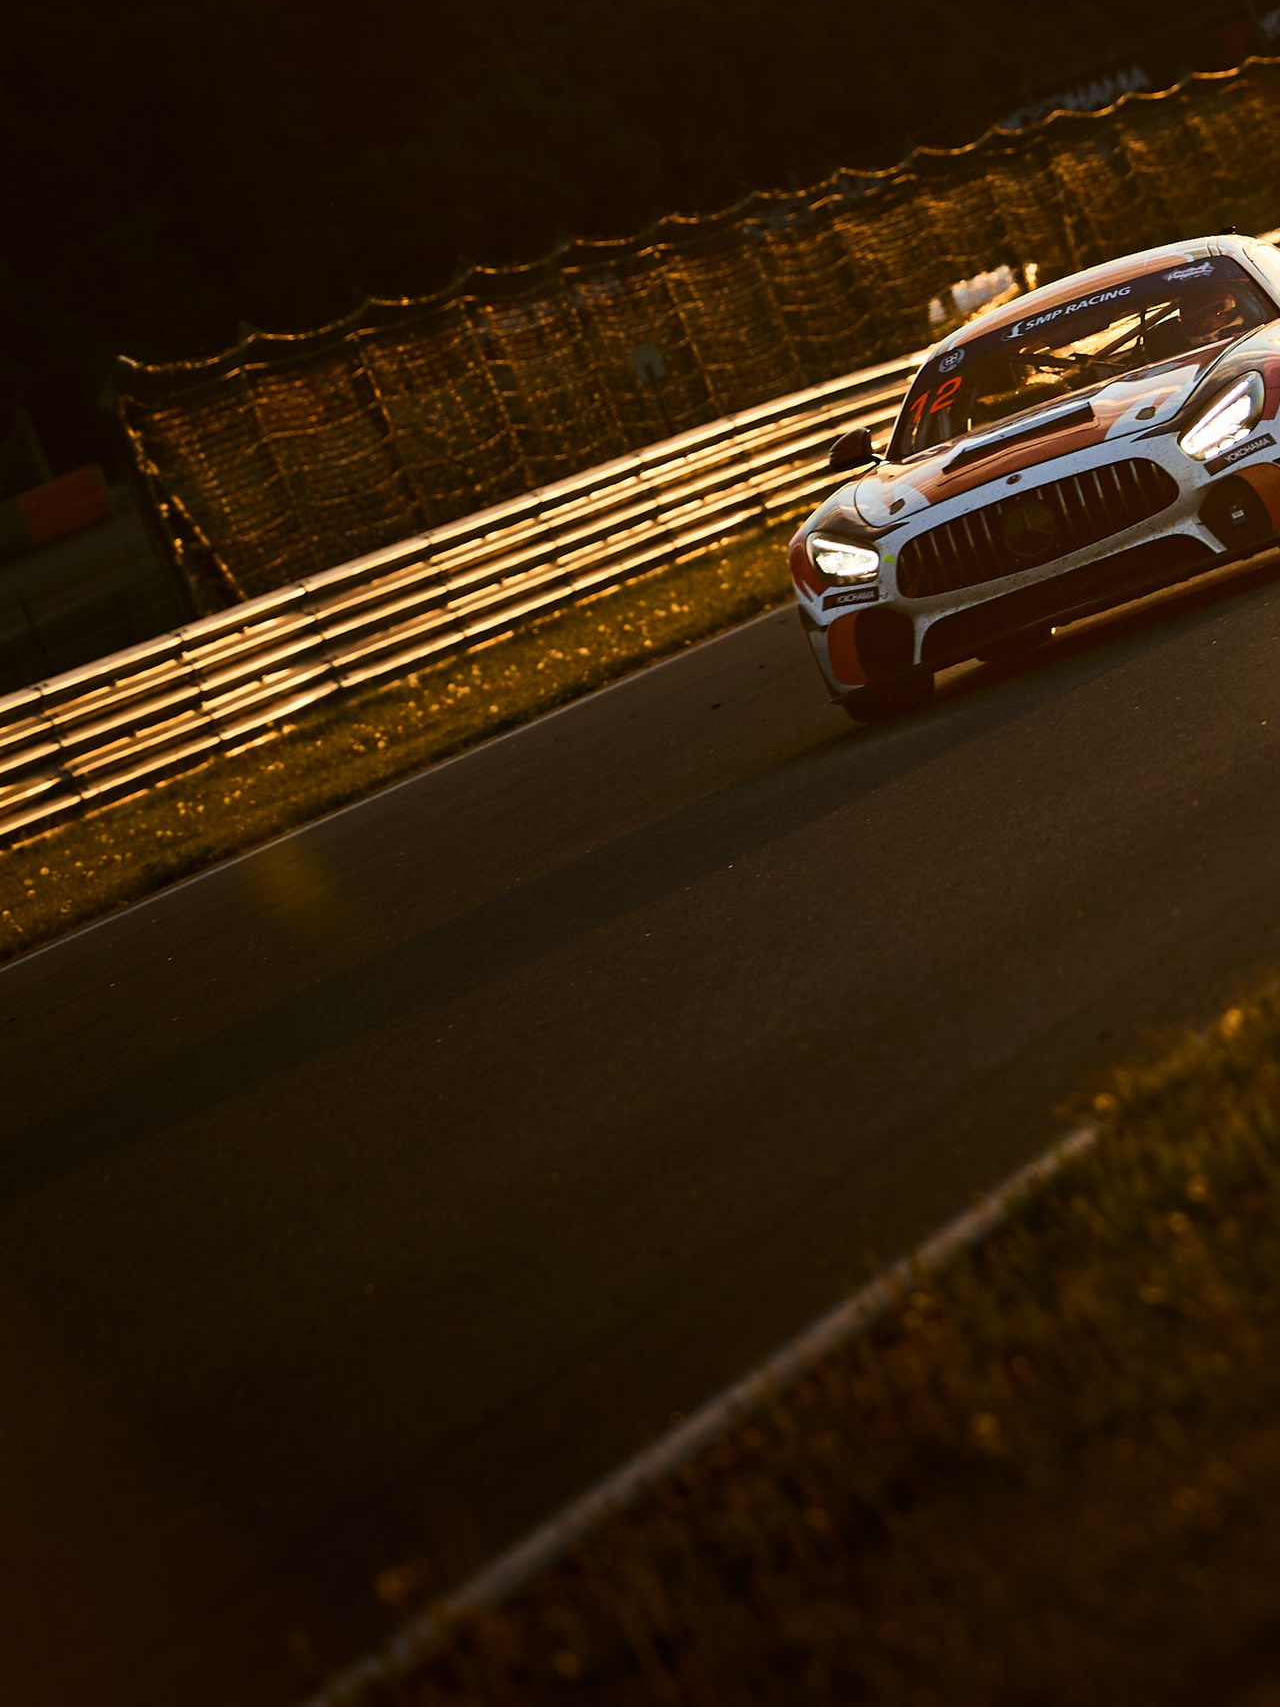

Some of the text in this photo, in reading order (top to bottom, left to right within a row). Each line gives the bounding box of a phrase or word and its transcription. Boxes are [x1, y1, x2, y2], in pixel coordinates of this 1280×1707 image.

[1024, 285, 1132, 331] SMP RACING
[909, 375, 963, 425] 12
[1224, 437, 1271, 464] YOKOHAMA
